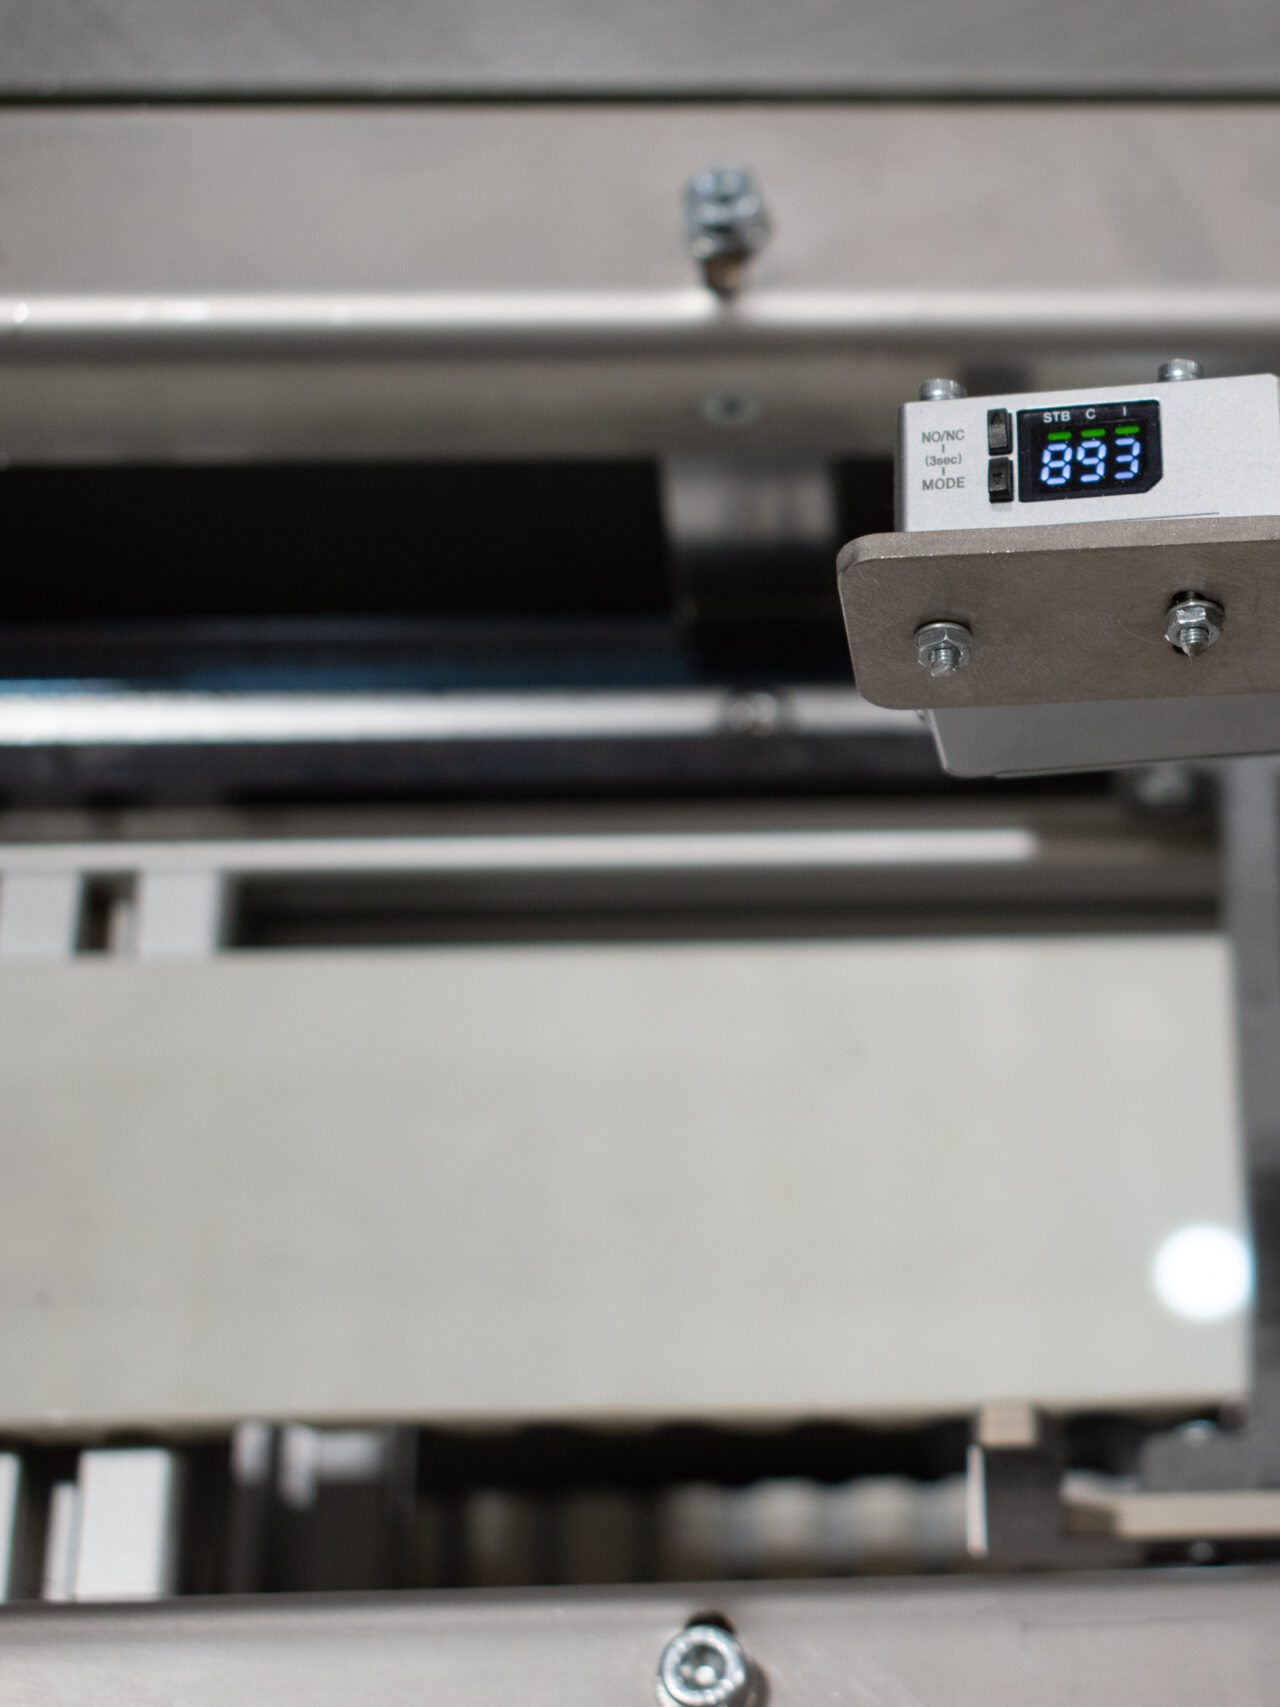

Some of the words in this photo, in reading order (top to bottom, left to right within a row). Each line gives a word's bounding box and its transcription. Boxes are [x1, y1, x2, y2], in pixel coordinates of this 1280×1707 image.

[1043, 410, 1071, 424] STB
[1085, 408, 1096, 420] C
[921, 429, 965, 443] NO/NC
[925, 453, 962, 467] (3sec)
[1040, 436, 1141, 486] 893
[922, 476, 965, 491] MODE
